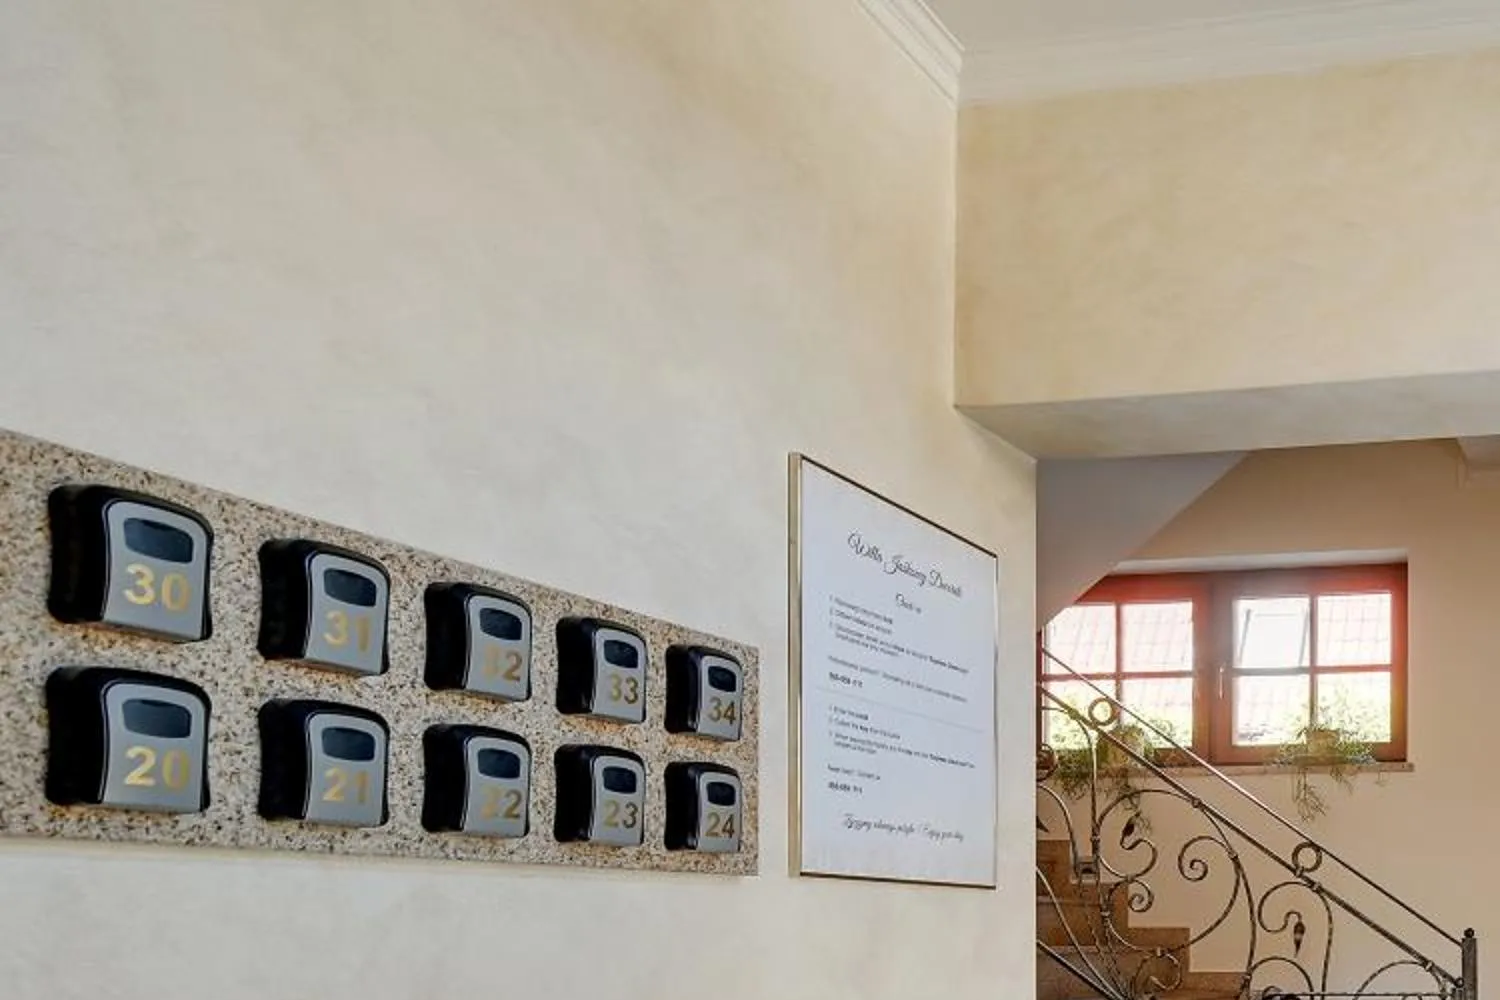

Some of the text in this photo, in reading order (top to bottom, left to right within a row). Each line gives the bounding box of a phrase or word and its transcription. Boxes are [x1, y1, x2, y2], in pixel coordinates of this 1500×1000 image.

[124, 563, 190, 612] 30
[324, 610, 371, 654] 31
[608, 673, 639, 705] 33
[708, 697, 736, 726] 34
[124, 745, 190, 790] 20
[324, 769, 370, 805] 21
[604, 801, 639, 830] 23
[706, 812, 736, 839] 24
